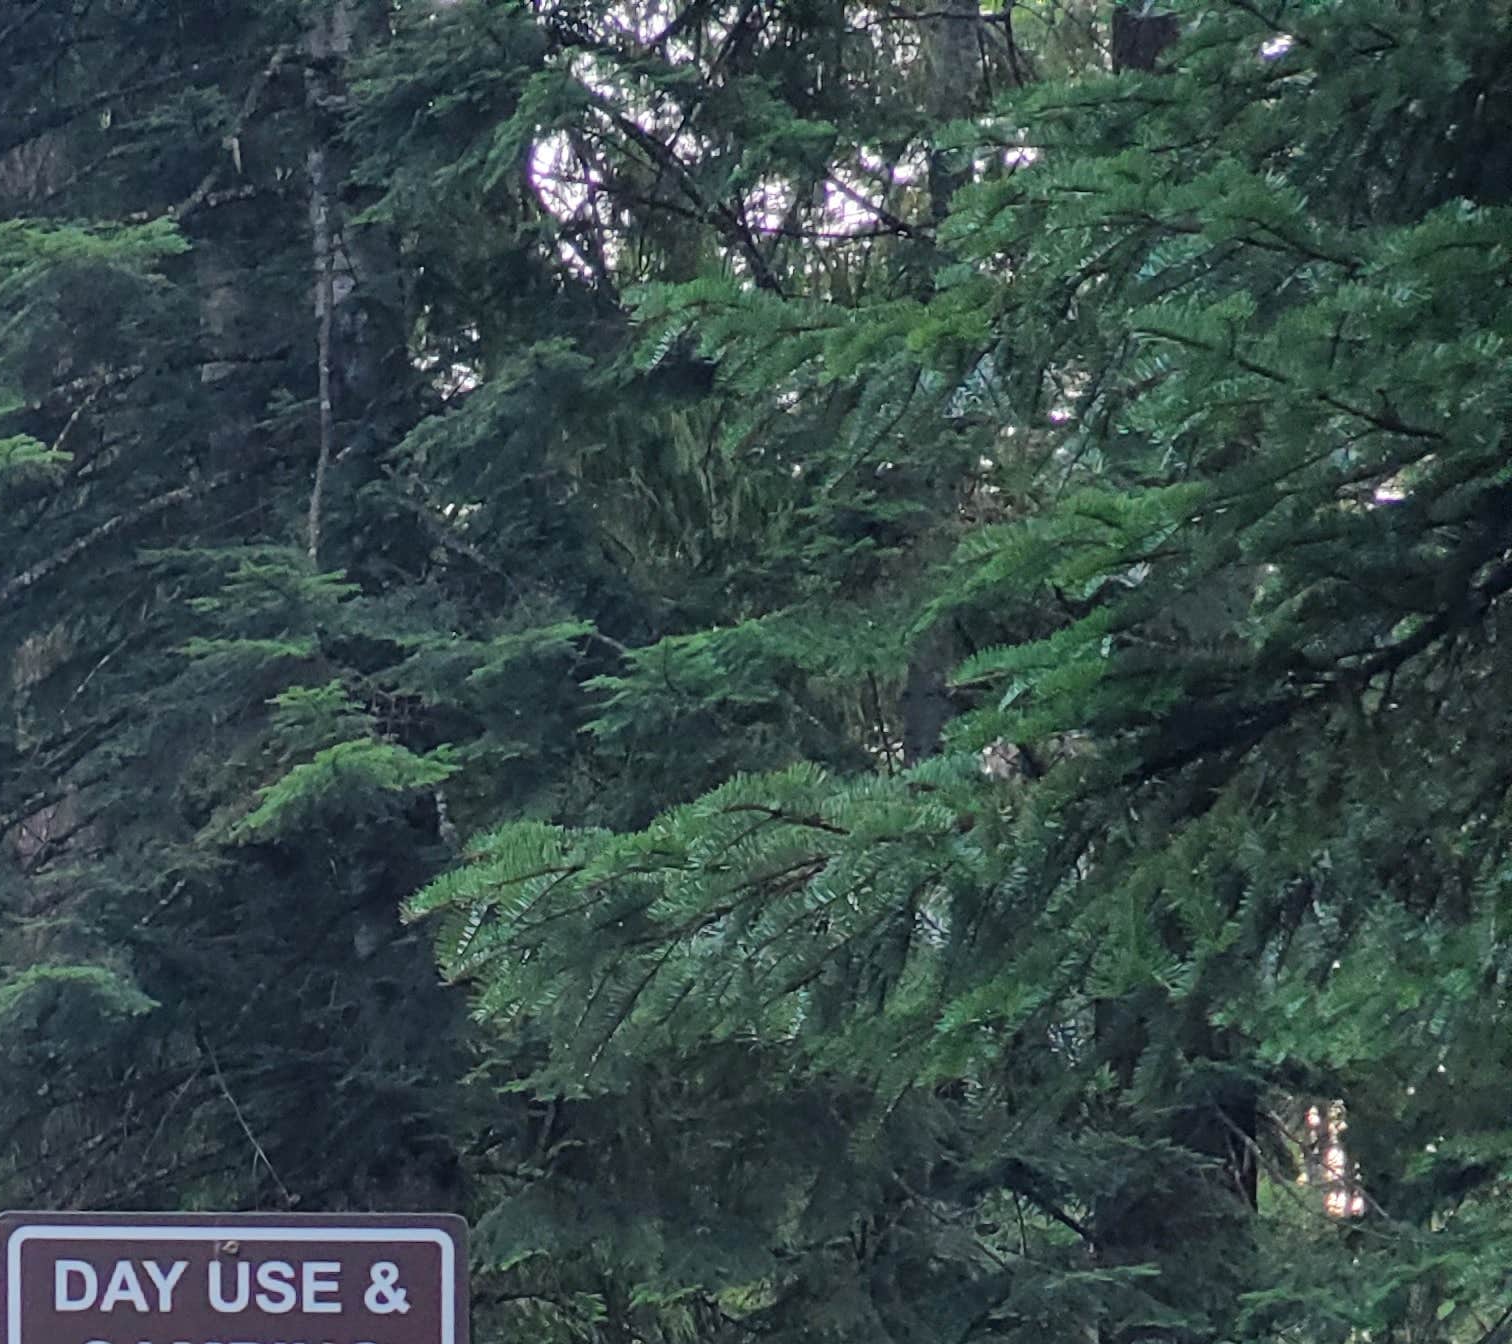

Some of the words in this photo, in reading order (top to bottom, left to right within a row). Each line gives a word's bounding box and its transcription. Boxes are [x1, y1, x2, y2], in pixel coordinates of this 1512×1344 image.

[56, 1260, 188, 1312] DAY
[209, 1260, 341, 1313] USE
[365, 1262, 410, 1313] &
